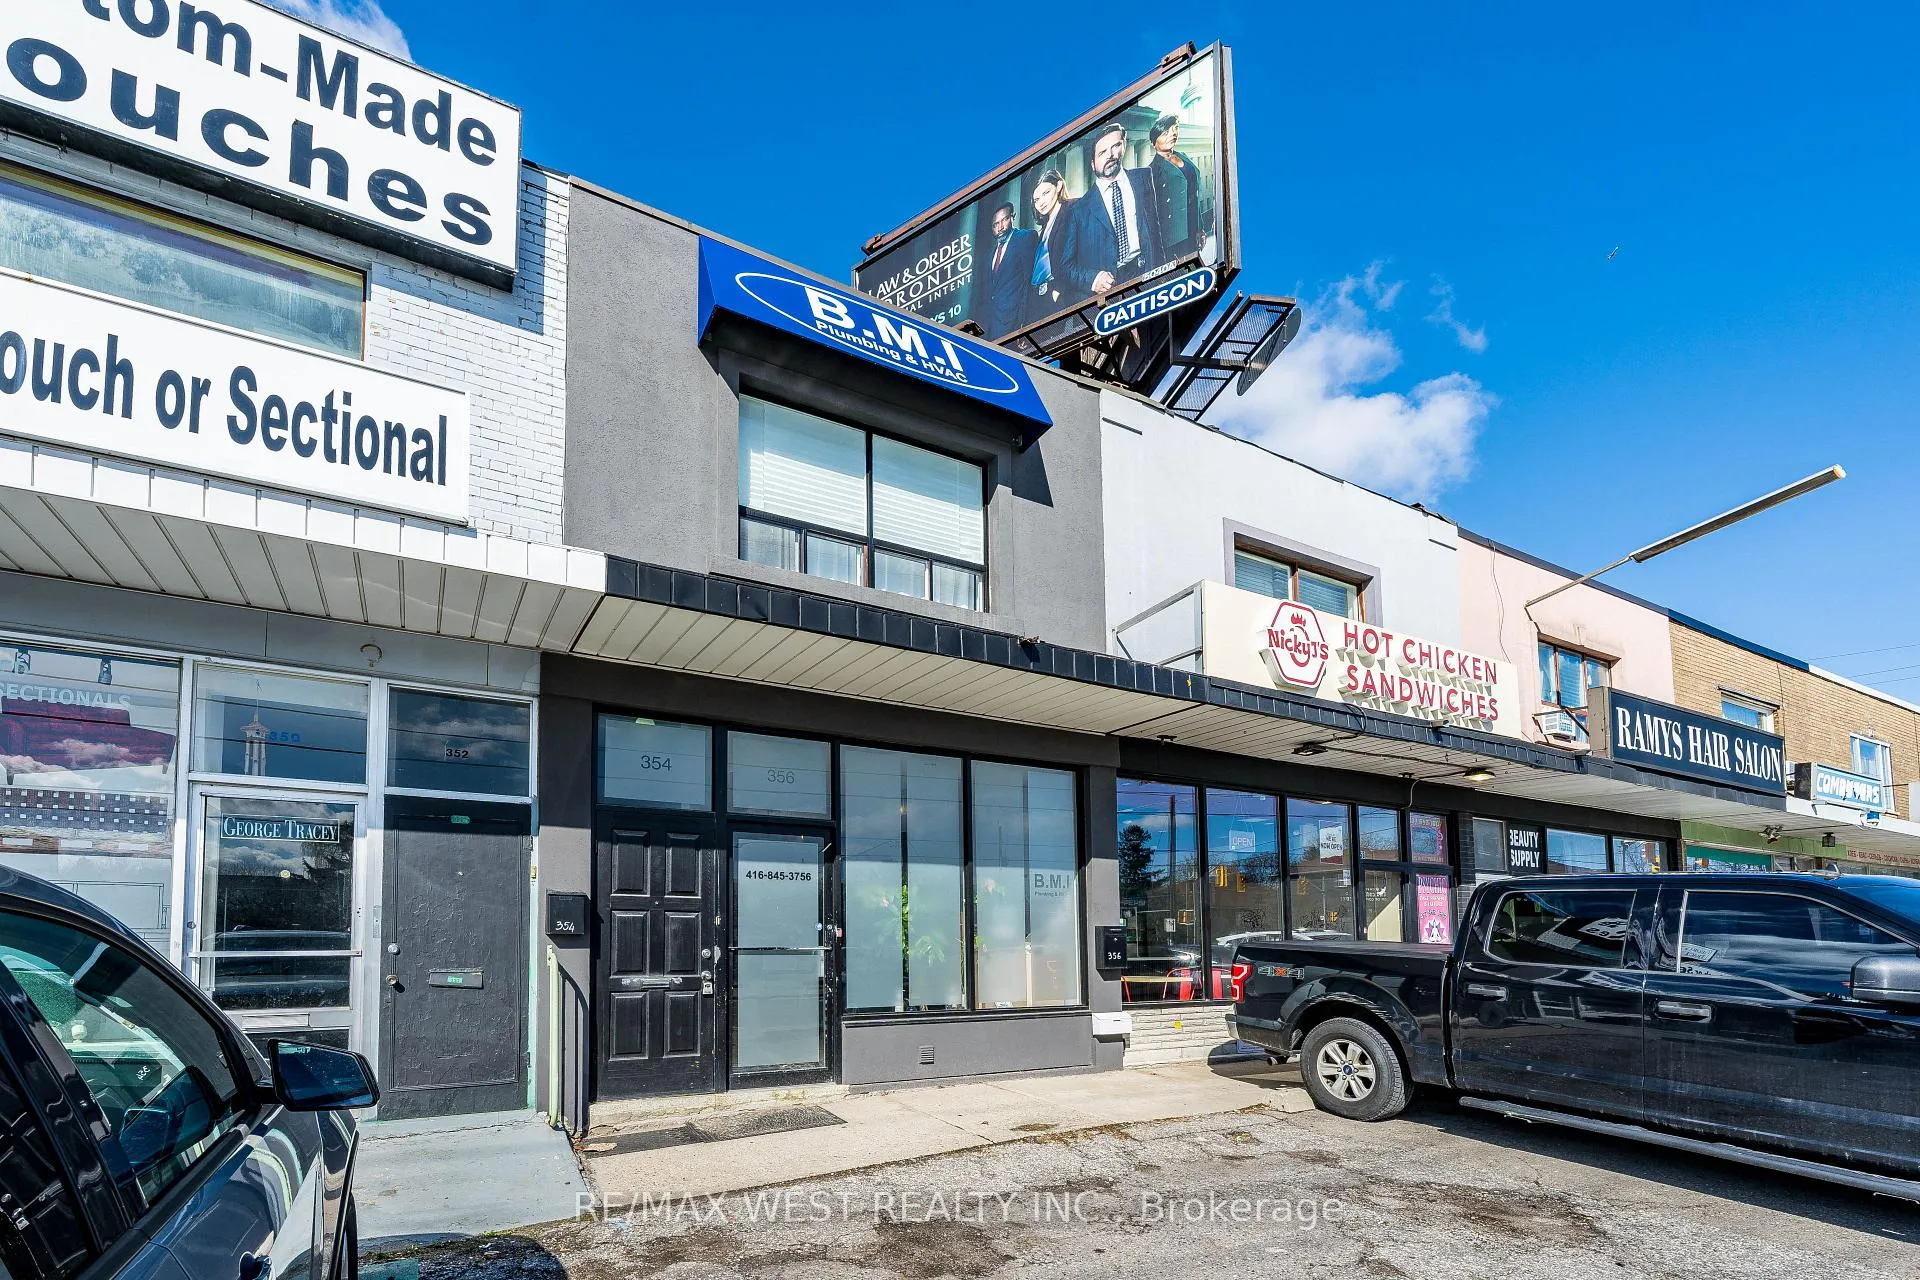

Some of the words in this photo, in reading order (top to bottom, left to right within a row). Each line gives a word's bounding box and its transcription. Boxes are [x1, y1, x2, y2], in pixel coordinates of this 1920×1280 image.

[6, 37, 493, 246] ouches
[902, 267, 916, 284] &
[915, 233, 972, 275] ORDER
[928, 273, 973, 303] INTENT
[948, 304, 962, 318] 10
[1103, 274, 1206, 329] PATTISON
[805, 286, 964, 372] B.M.I
[815, 319, 901, 361] Plumbing
[908, 353, 919, 366] &
[922, 359, 969, 383] HVAC
[155, 368, 211, 434] or
[227, 365, 448, 487] Sectional
[1343, 622, 1394, 658] HOT
[1402, 638, 1498, 685] CHICKEN
[1346, 664, 1499, 721] SANDWICHES
[446, 748, 469, 760] 352
[1615, 706, 1684, 761] RAMYS
[1686, 725, 1732, 772] HAIR
[1734, 737, 1783, 783] SALON
[640, 755, 672, 772] 354
[767, 769, 795, 784] 356
[223, 816, 282, 839] GEORGE
[285, 818, 337, 841] TRACEY
[1509, 829, 1539, 849] BEAUTY
[1231, 837, 1254, 848] OPEN
[1510, 849, 1540, 868] SUPPLY
[745, 870, 812, 881] 416-845-3756
[1034, 873, 1070, 889] B.M.I
[555, 920, 575, 933] 354
[1107, 951, 1122, 960] 356
